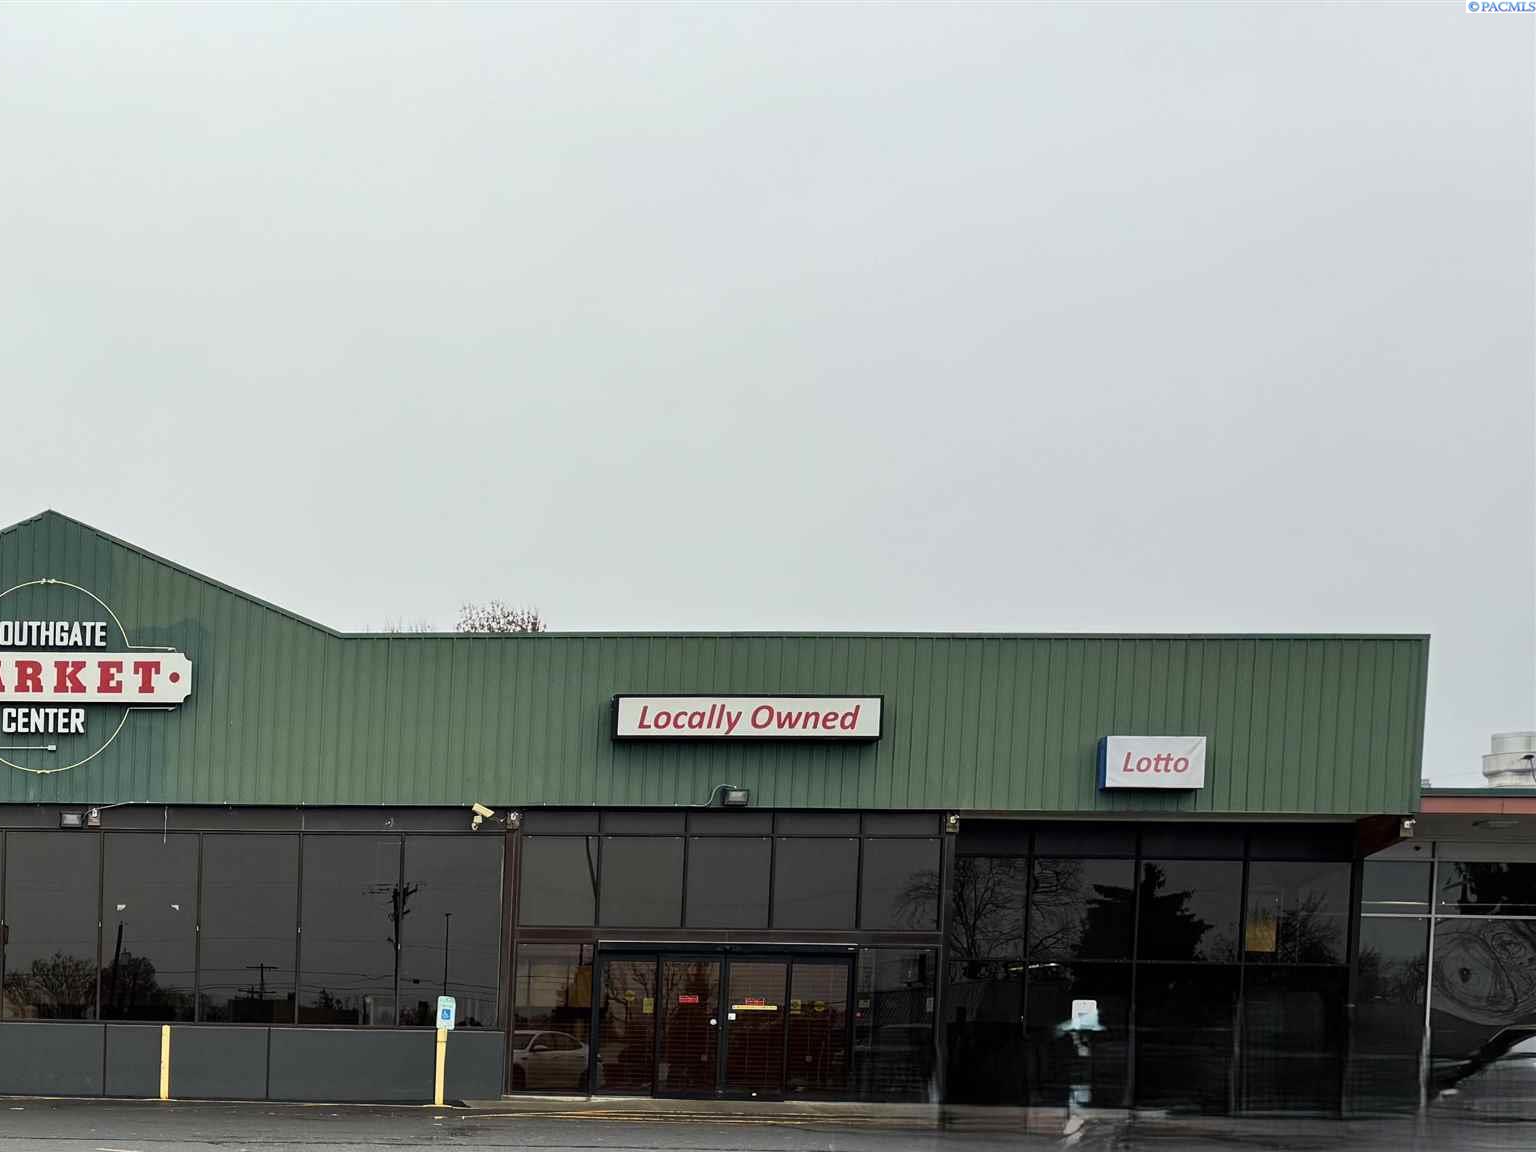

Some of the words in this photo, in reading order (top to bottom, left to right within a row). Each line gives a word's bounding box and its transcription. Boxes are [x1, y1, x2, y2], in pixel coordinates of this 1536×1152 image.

[2, 707, 85, 734] CENTER
[638, 704, 743, 735] Locally
[751, 704, 861, 730] Owned
[1122, 751, 1190, 773] Lotto
